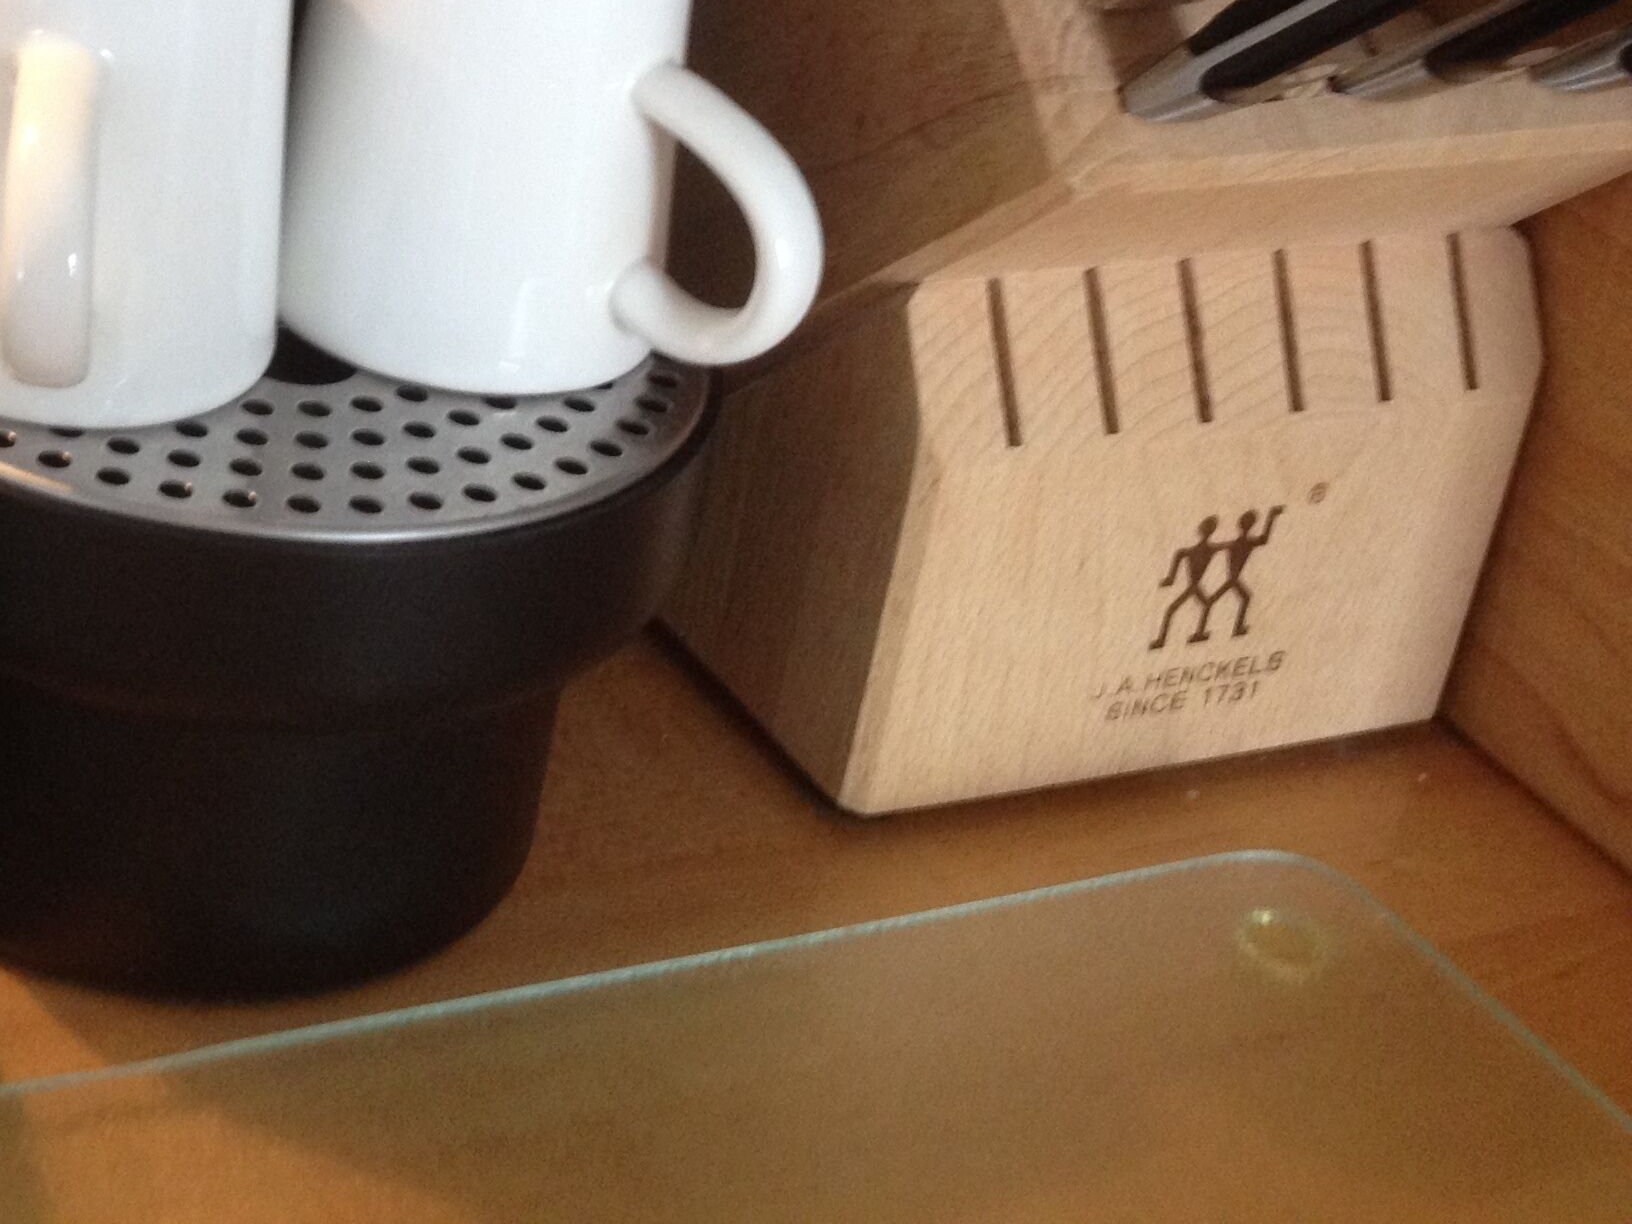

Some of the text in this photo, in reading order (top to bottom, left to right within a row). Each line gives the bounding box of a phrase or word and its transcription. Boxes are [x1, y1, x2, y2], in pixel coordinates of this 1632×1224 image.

[1144, 650, 1285, 690] HENCKELS
[1104, 680, 1260, 720] SINCE 1731
